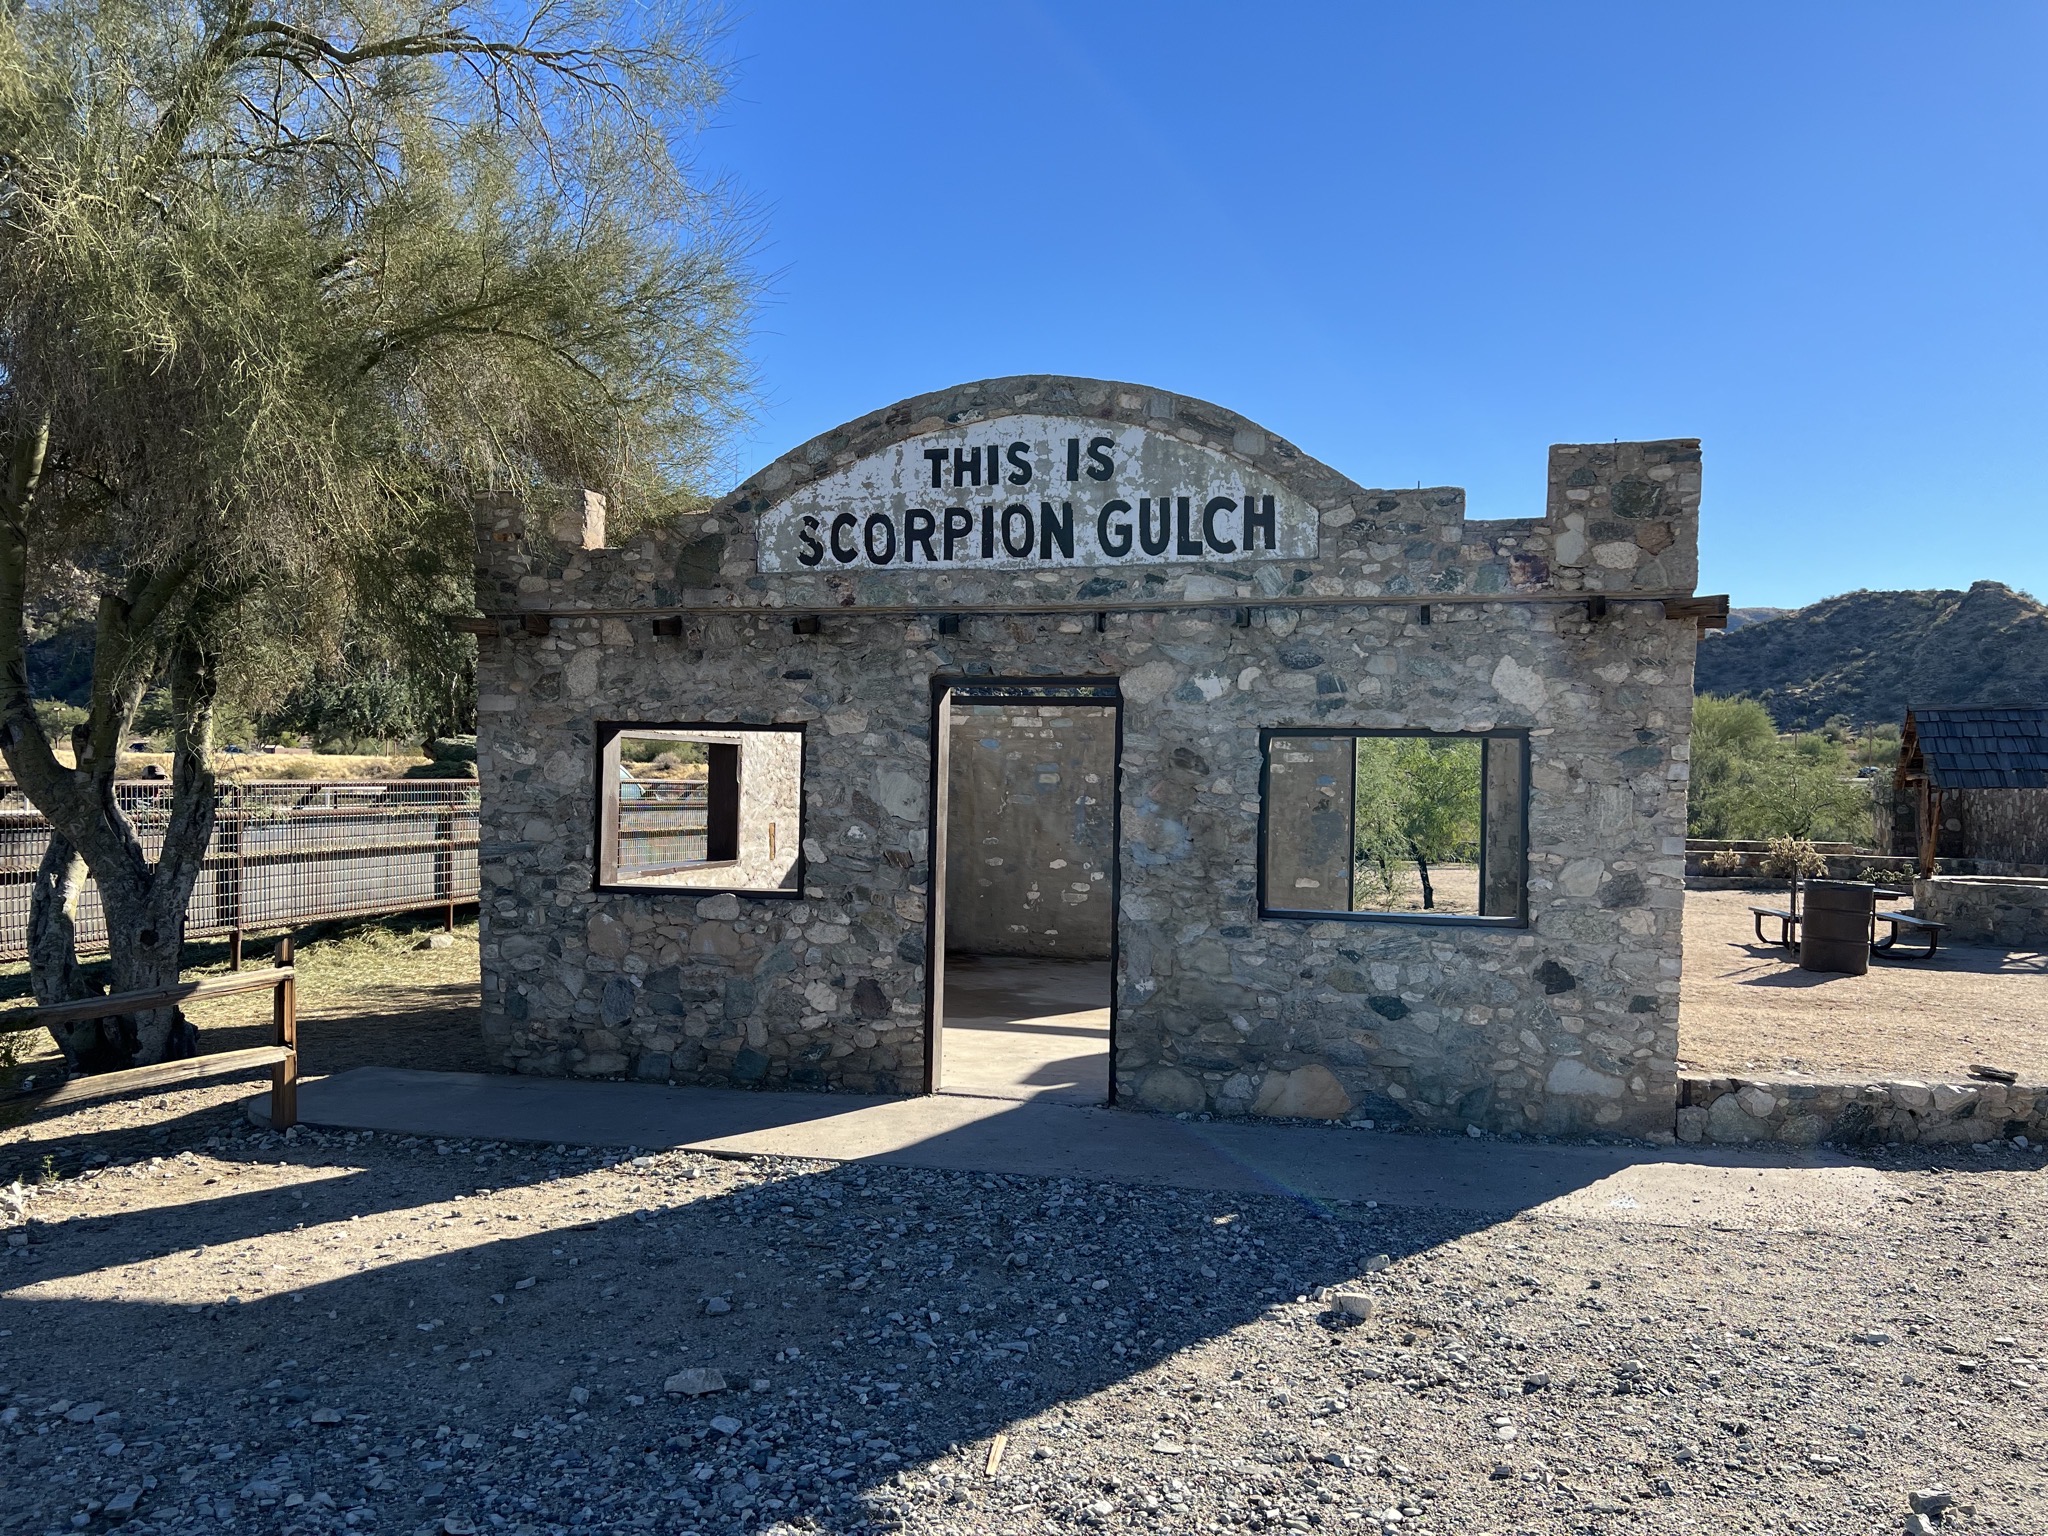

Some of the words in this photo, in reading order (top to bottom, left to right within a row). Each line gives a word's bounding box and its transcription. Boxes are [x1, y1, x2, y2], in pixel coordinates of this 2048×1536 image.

[924, 441, 1034, 488] THIS
[1066, 437, 1116, 482] IS
[797, 502, 1075, 566] SCORPION
[1098, 495, 1276, 557] GULCH
